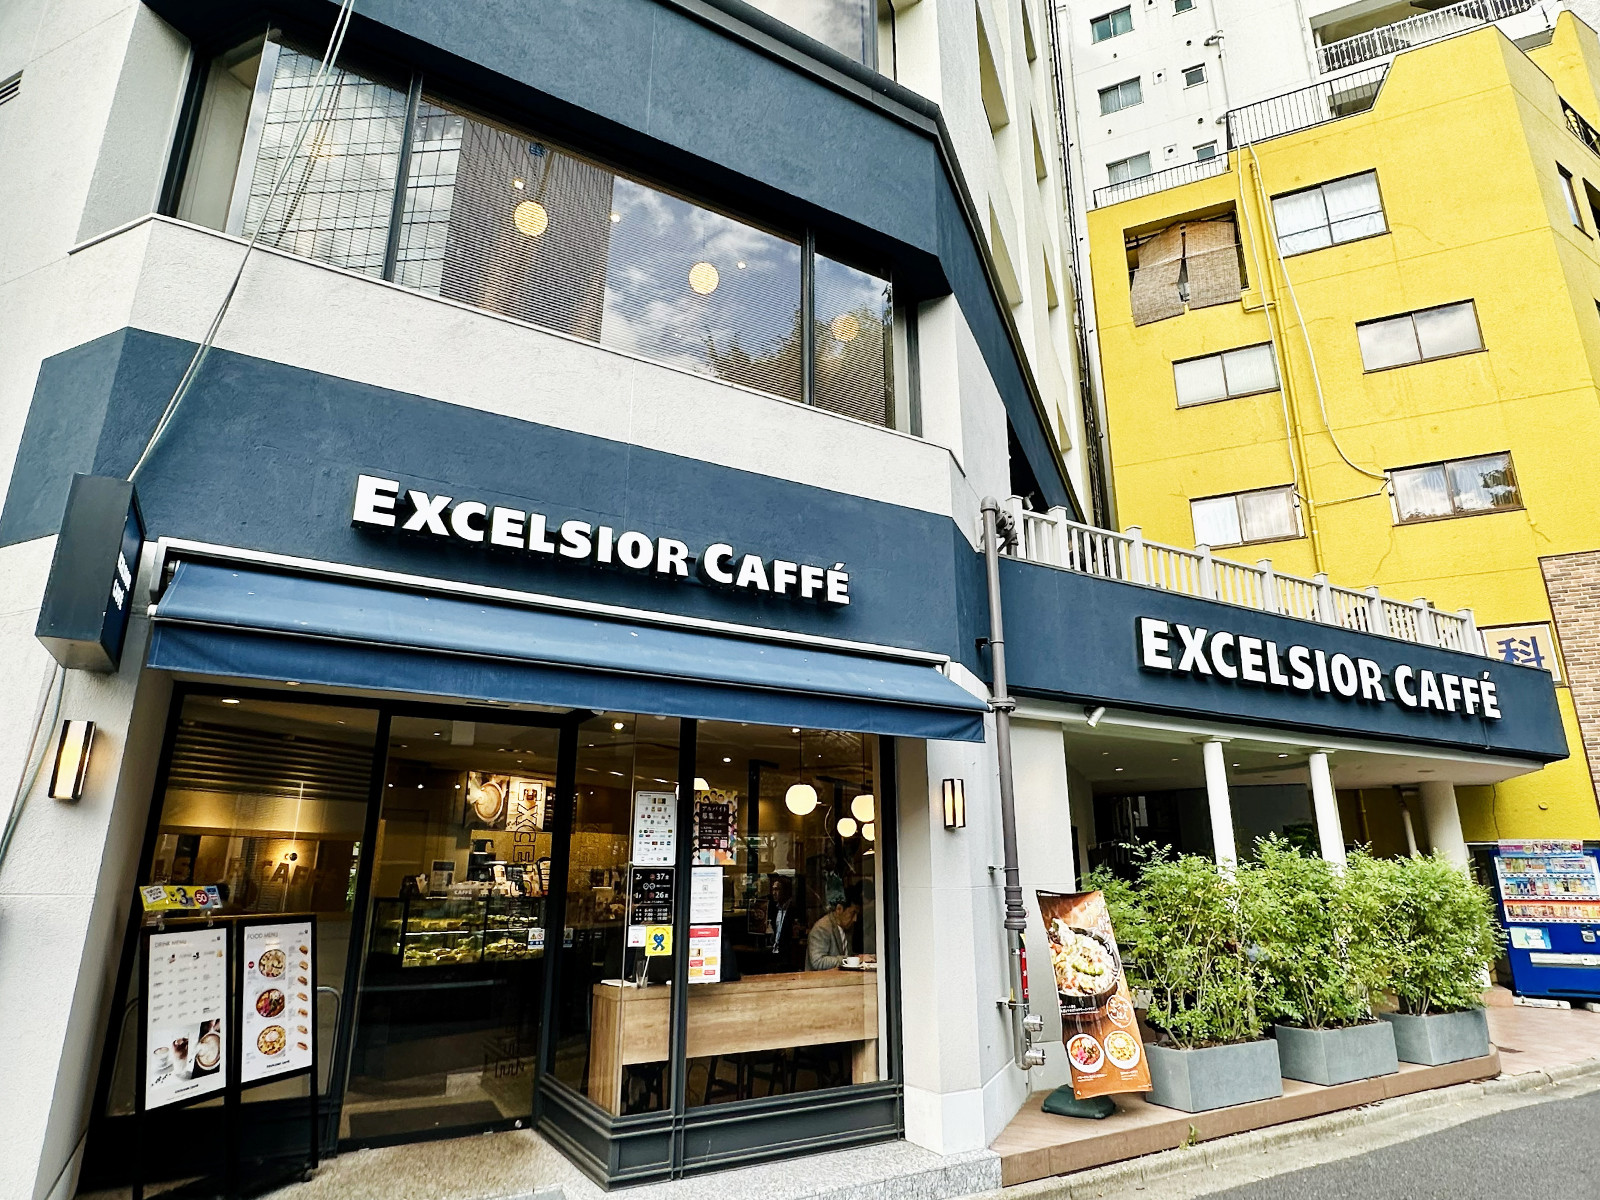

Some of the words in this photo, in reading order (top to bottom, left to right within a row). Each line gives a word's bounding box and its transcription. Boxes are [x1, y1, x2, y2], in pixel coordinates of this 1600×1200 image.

[351, 473, 690, 577] EXCELSIOR
[703, 542, 851, 605] CAFFÉ
[1139, 616, 1387, 702] EXCELSIOR
[1393, 664, 1502, 720] CAFFÉ
[1496, 636, 1545, 668] 科
